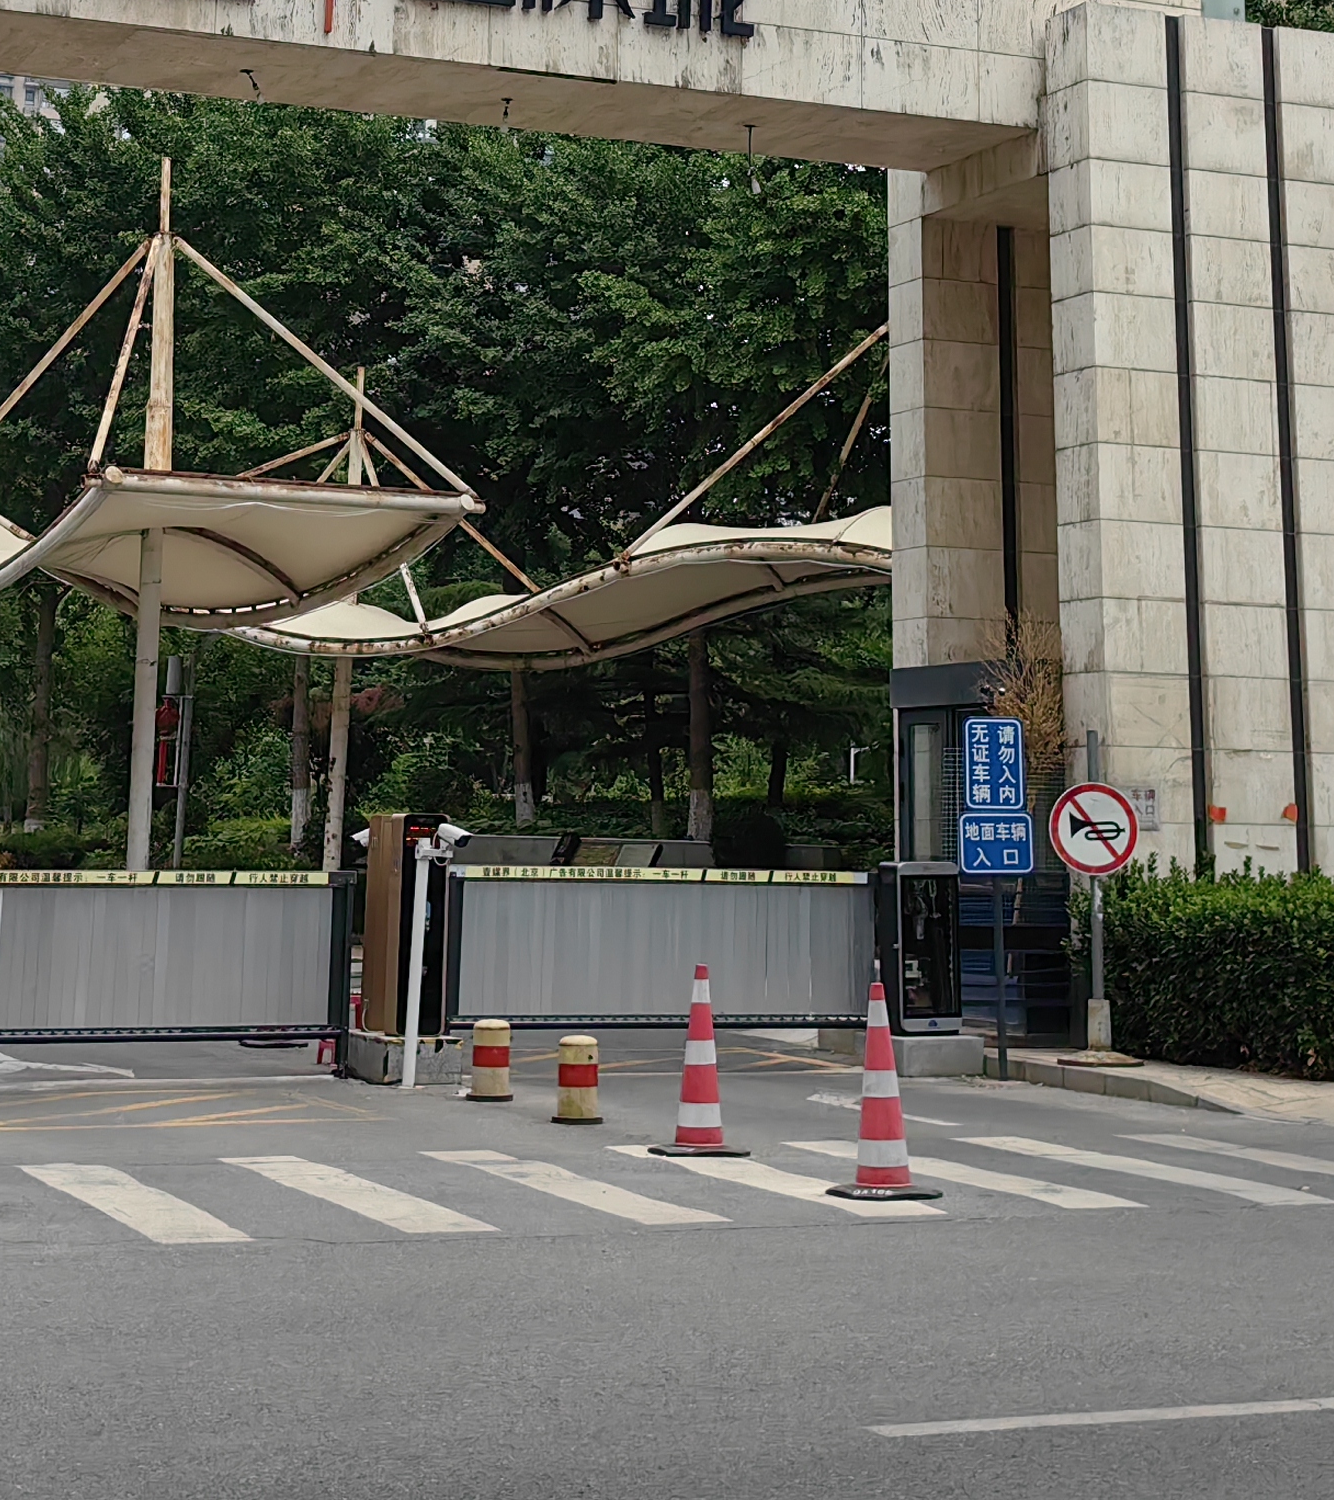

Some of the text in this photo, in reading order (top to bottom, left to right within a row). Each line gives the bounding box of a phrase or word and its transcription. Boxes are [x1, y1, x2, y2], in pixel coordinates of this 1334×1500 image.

[971, 724, 991, 803] 无证车辆
[997, 726, 1016, 804] 请勿入内
[965, 823, 1026, 842] 地面车辆
[973, 847, 1019, 867] 入口
